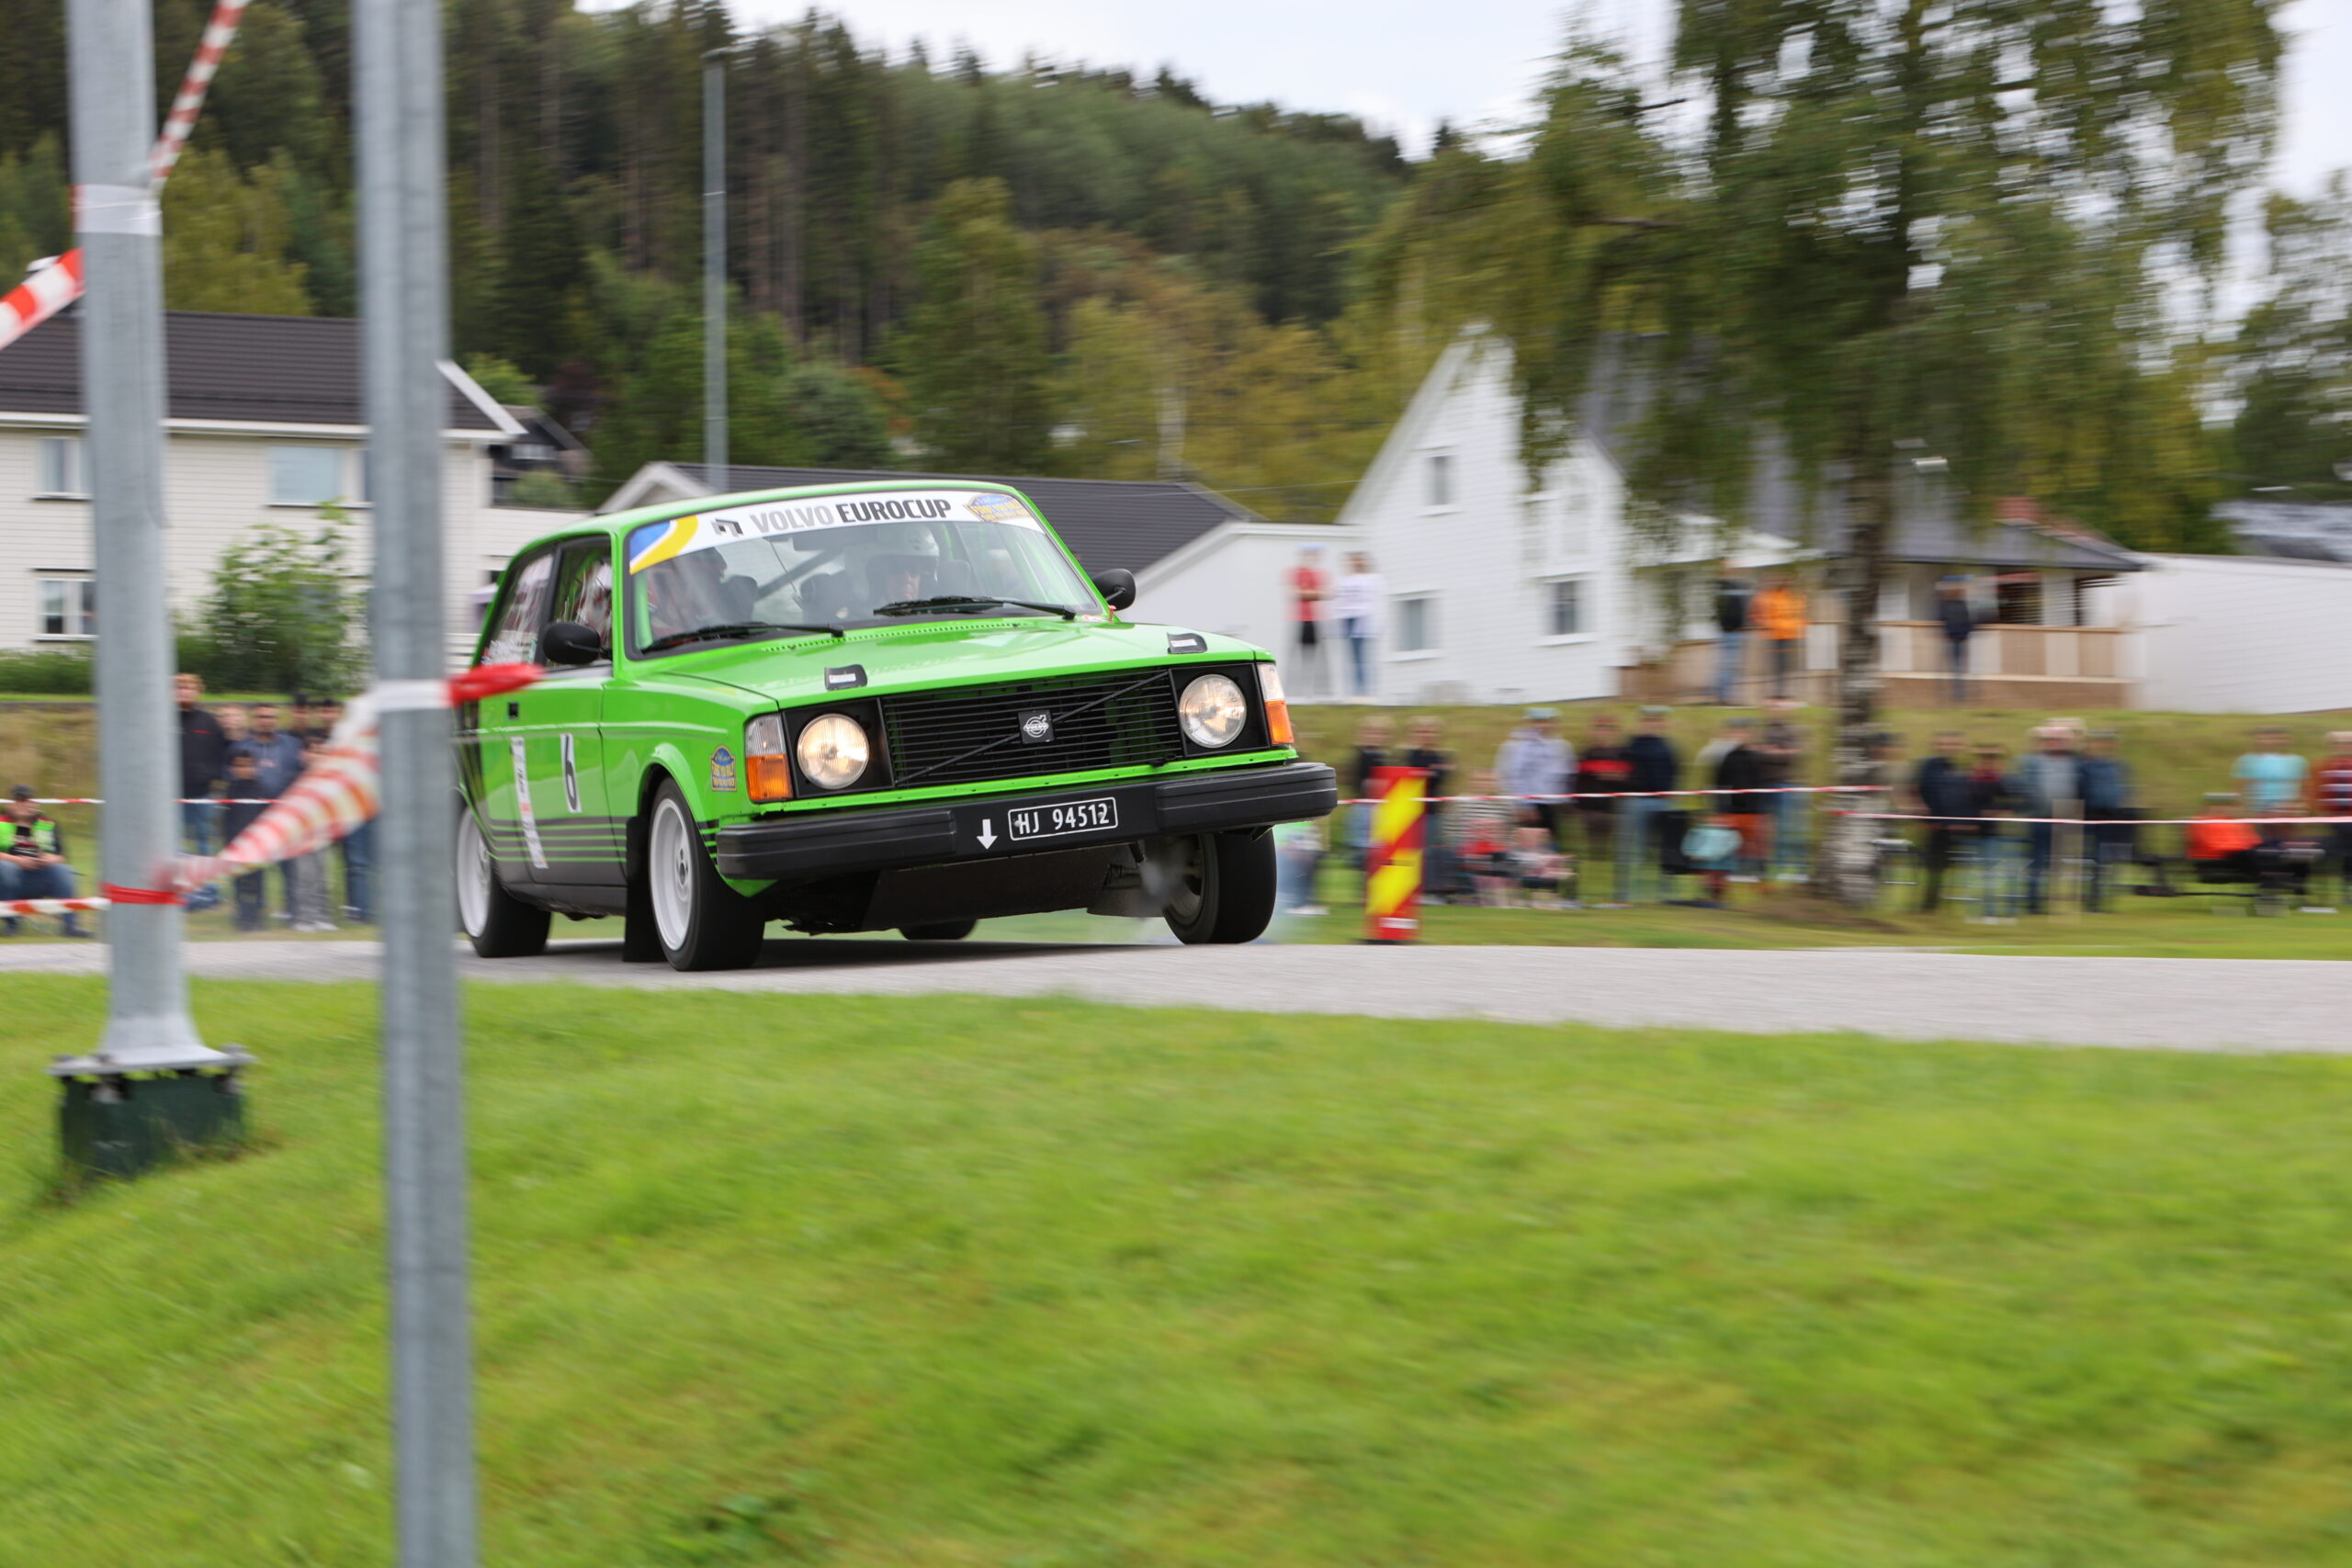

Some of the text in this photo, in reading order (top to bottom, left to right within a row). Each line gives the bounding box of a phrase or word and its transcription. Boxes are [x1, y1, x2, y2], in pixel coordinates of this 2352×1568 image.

[750, 505, 834, 534] VOLVO
[835, 499, 951, 524] EUROCUP
[564, 735, 577, 810] 6
[1017, 803, 1110, 835] HJ 94512
